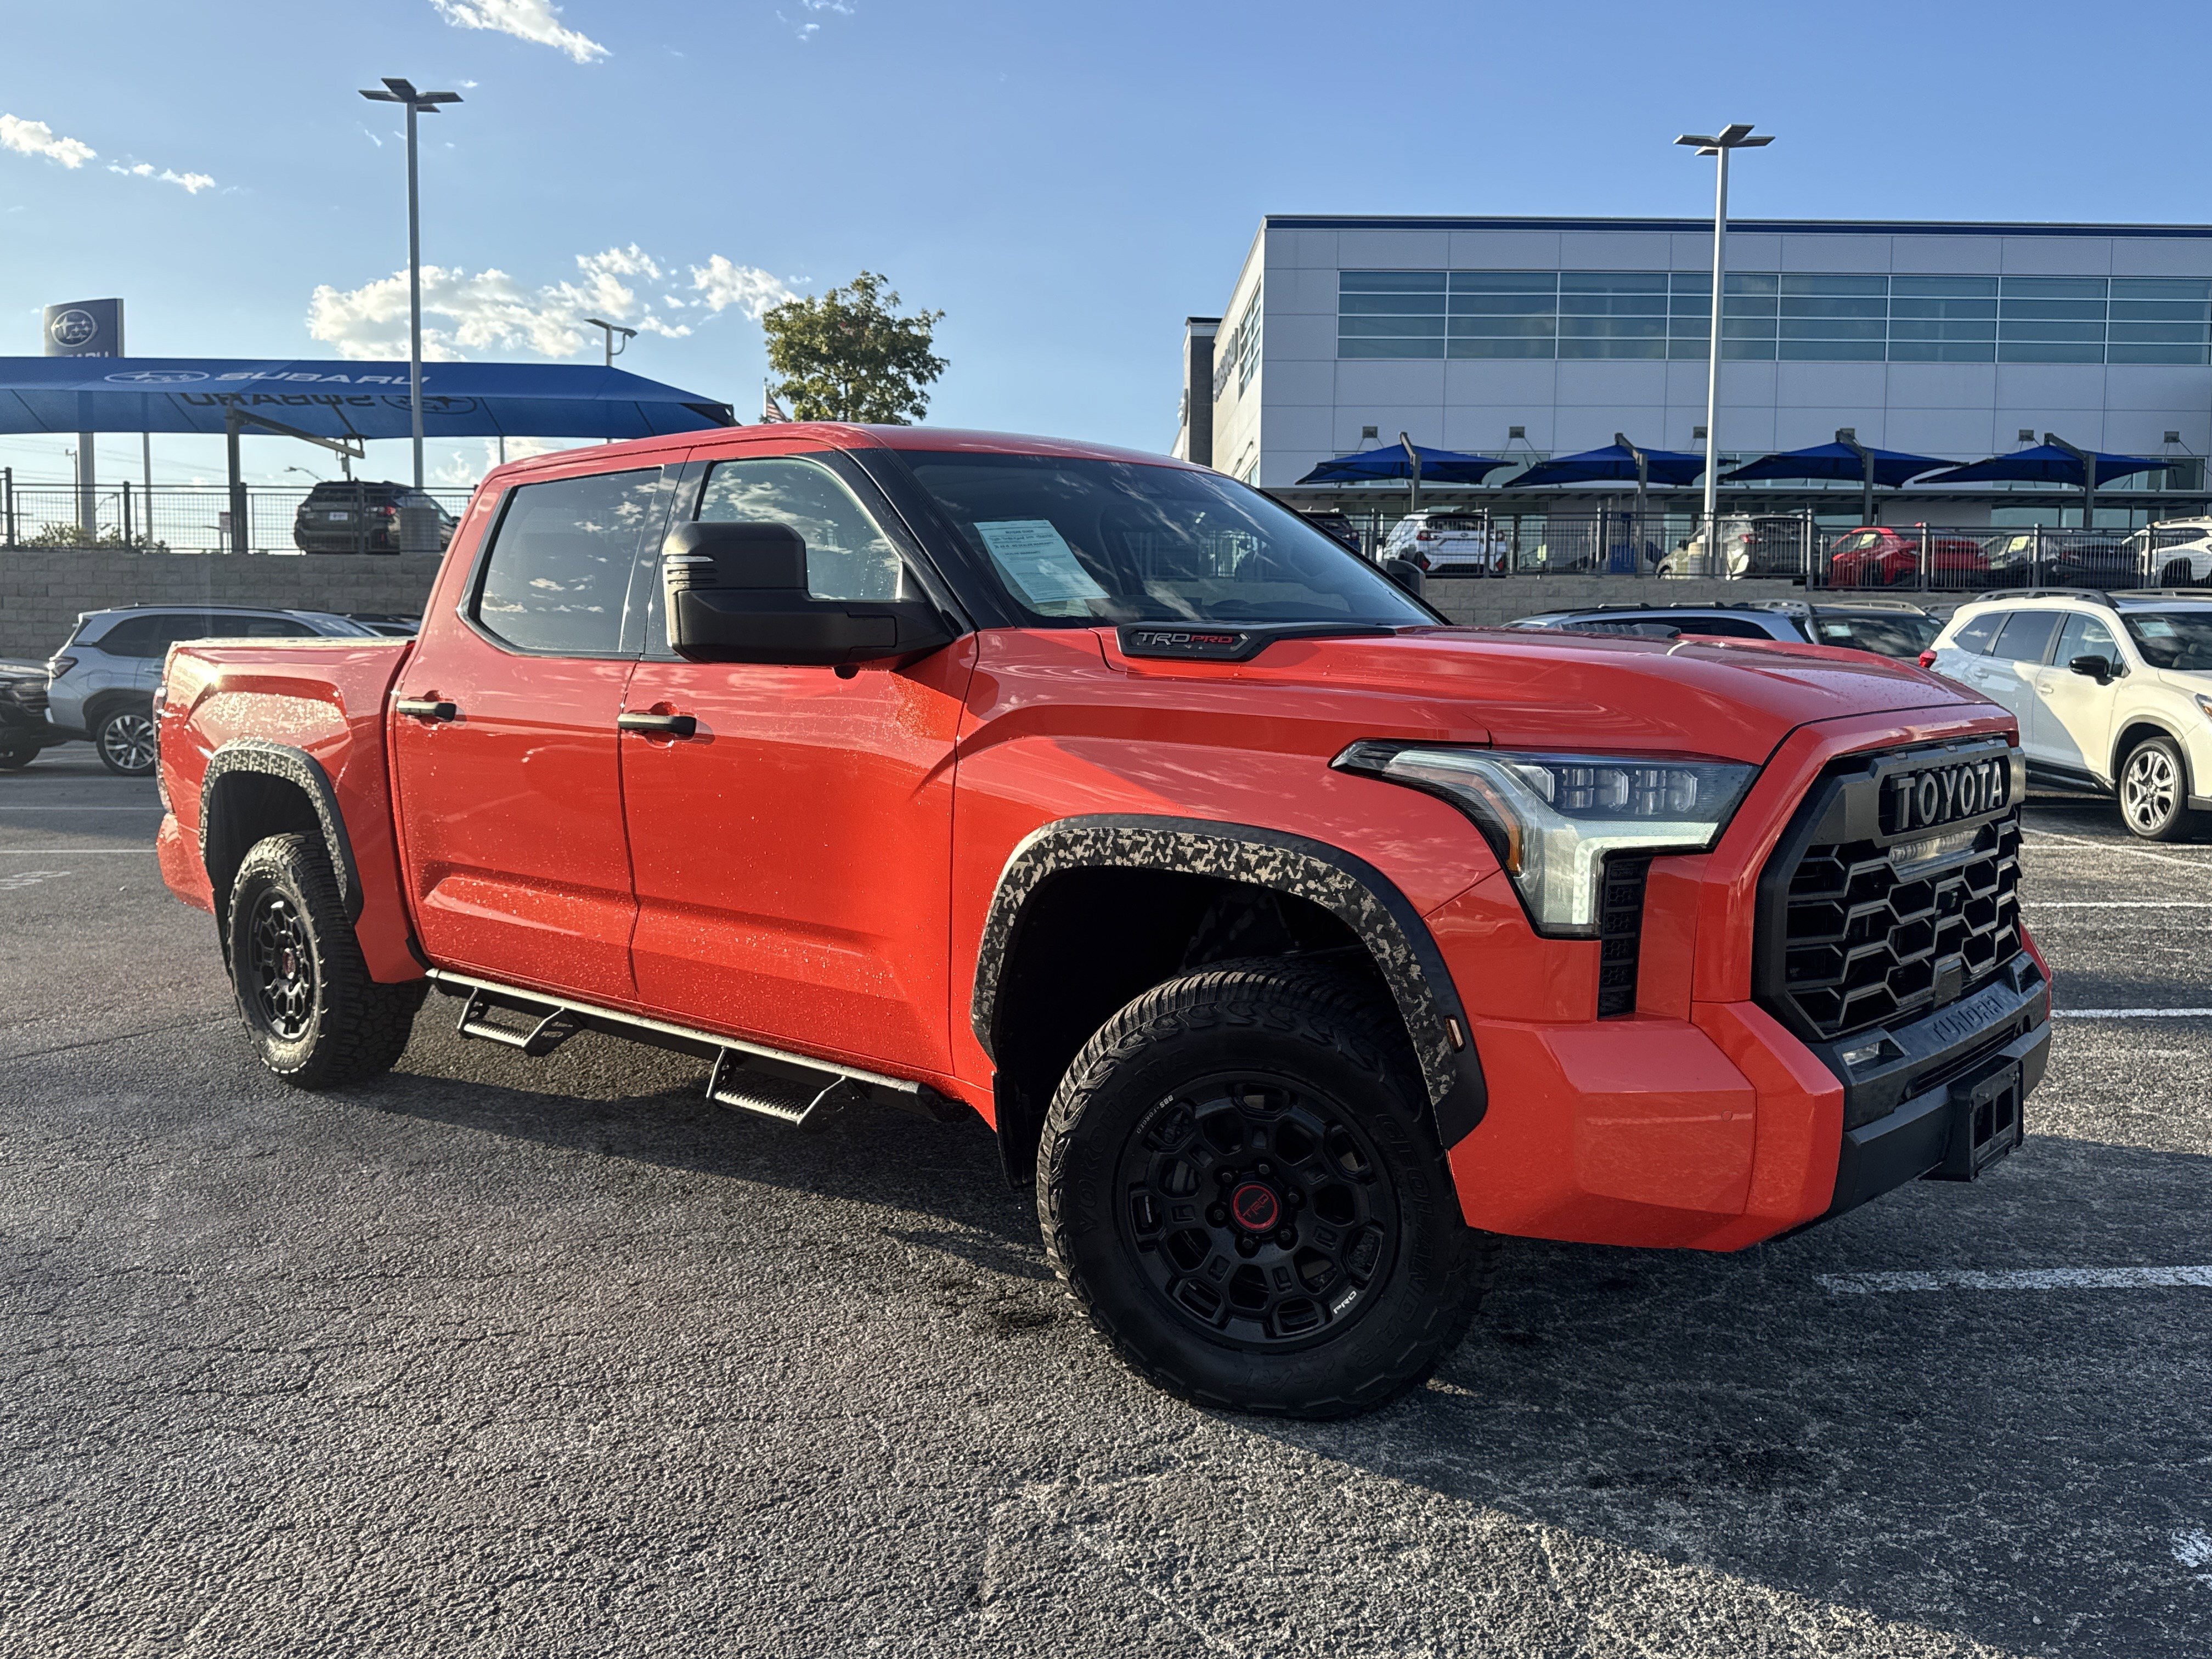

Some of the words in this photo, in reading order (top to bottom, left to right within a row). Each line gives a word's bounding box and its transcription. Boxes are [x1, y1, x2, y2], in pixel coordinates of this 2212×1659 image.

[215, 371, 430, 385] SUBARU
[1138, 632, 1190, 646] TRD
[1190, 635, 1234, 644] PRO
[1896, 761, 2002, 830] TOYOTA
[1925, 994, 2004, 1042] TUNDRA
[1078, 1048, 1189, 1232] YOKOHAMA
[1242, 1194, 1269, 1218] TRD
[1333, 1290, 1357, 1314] PRO
